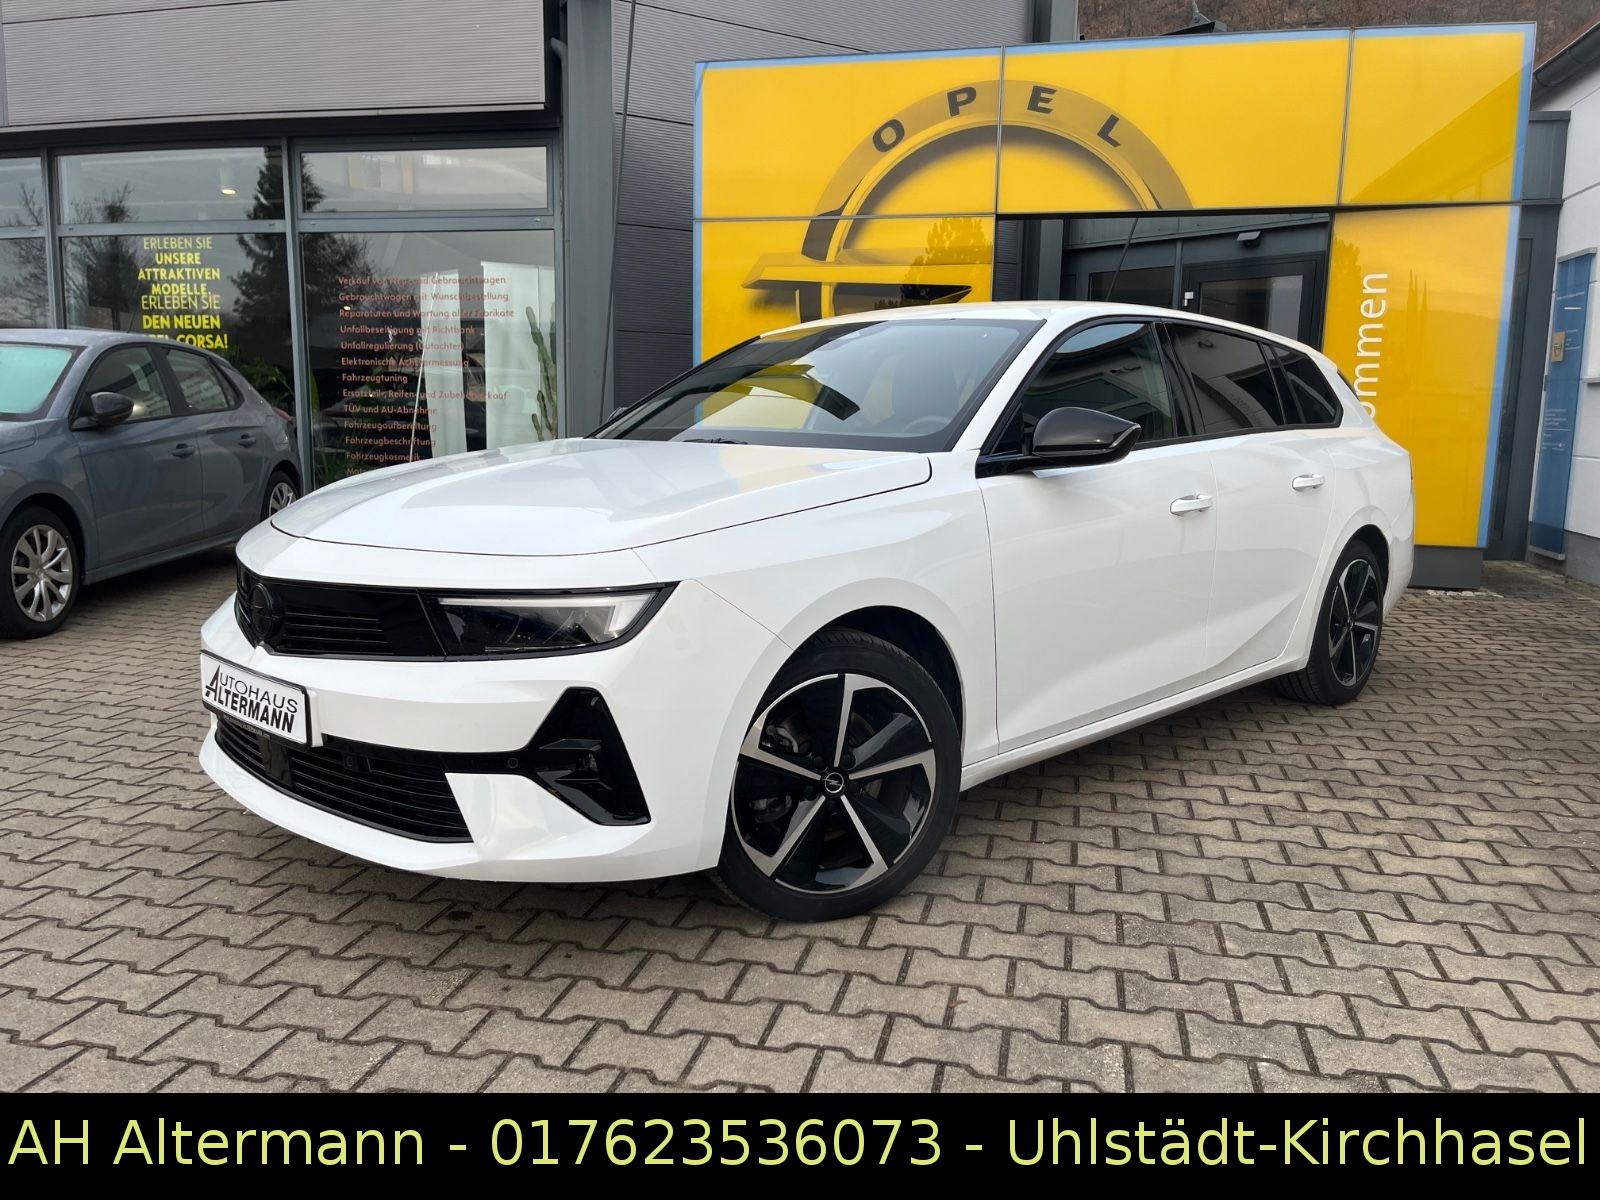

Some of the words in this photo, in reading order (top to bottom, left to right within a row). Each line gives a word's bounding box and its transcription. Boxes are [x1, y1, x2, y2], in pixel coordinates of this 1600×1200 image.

[872, 85, 1121, 153] OPEL
[143, 237, 192, 249] ERLEBEN
[196, 237, 213, 249] SIE
[155, 252, 202, 265] UNSERE
[138, 267, 220, 280] ATTRAKTIVEN
[338, 275, 370, 286] Verkauf
[141, 294, 198, 310] ERLEBEN
[201, 294, 221, 310] SIE
[338, 292, 412, 303] Gebrauchtwagen
[339, 309, 392, 319] Reparaturen
[394, 309, 411, 318] und
[413, 309, 450, 319] Wartung
[142, 314, 171, 329] DEN
[173, 314, 221, 329] NEUEN
[340, 325, 415, 336] Unfallbeseitigung
[432, 325, 475, 335] Richtbank
[340, 341, 414, 352] Unfallregulierung
[341, 357, 397, 367] Elektronische
[341, 372, 408, 384] Fahrzeugtuning
[388, 389, 417, 398] Reifen-
[343, 402, 360, 413] TÜV
[363, 405, 379, 414] und
[381, 405, 437, 415] AU-Abnahme
[344, 420, 437, 432] Fahrzeugaufbereitung
[345, 436, 437, 448] Fahrzeugbeschriftung
[346, 452, 420, 463] Fahrzeugkosmetik
[205, 664, 298, 714] AUTOHAUS
